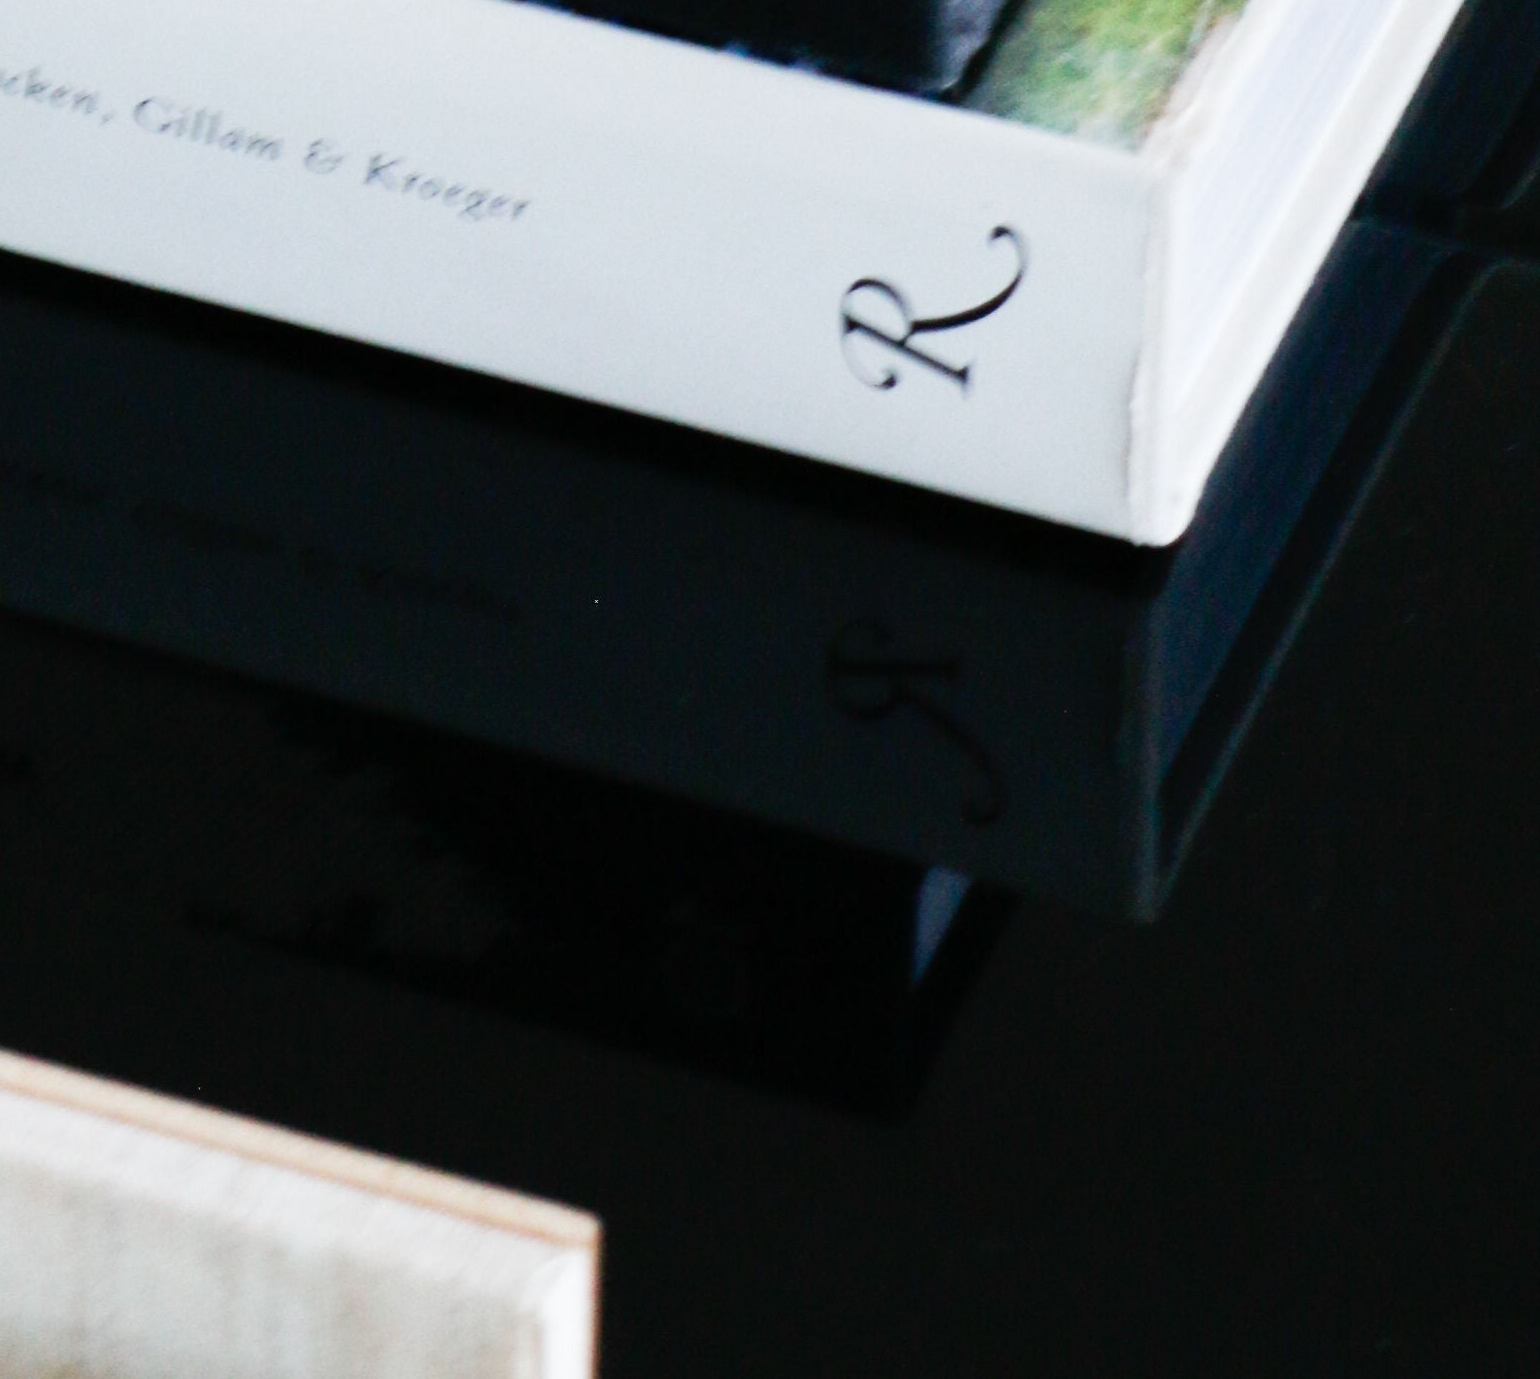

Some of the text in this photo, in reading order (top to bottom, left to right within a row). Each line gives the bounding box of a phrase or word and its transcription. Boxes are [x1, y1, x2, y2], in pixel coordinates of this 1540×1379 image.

[132, 95, 284, 162] Gillam
[303, 138, 345, 176] &
[363, 151, 530, 224] Kroeger
[839, 223, 1029, 396] R
